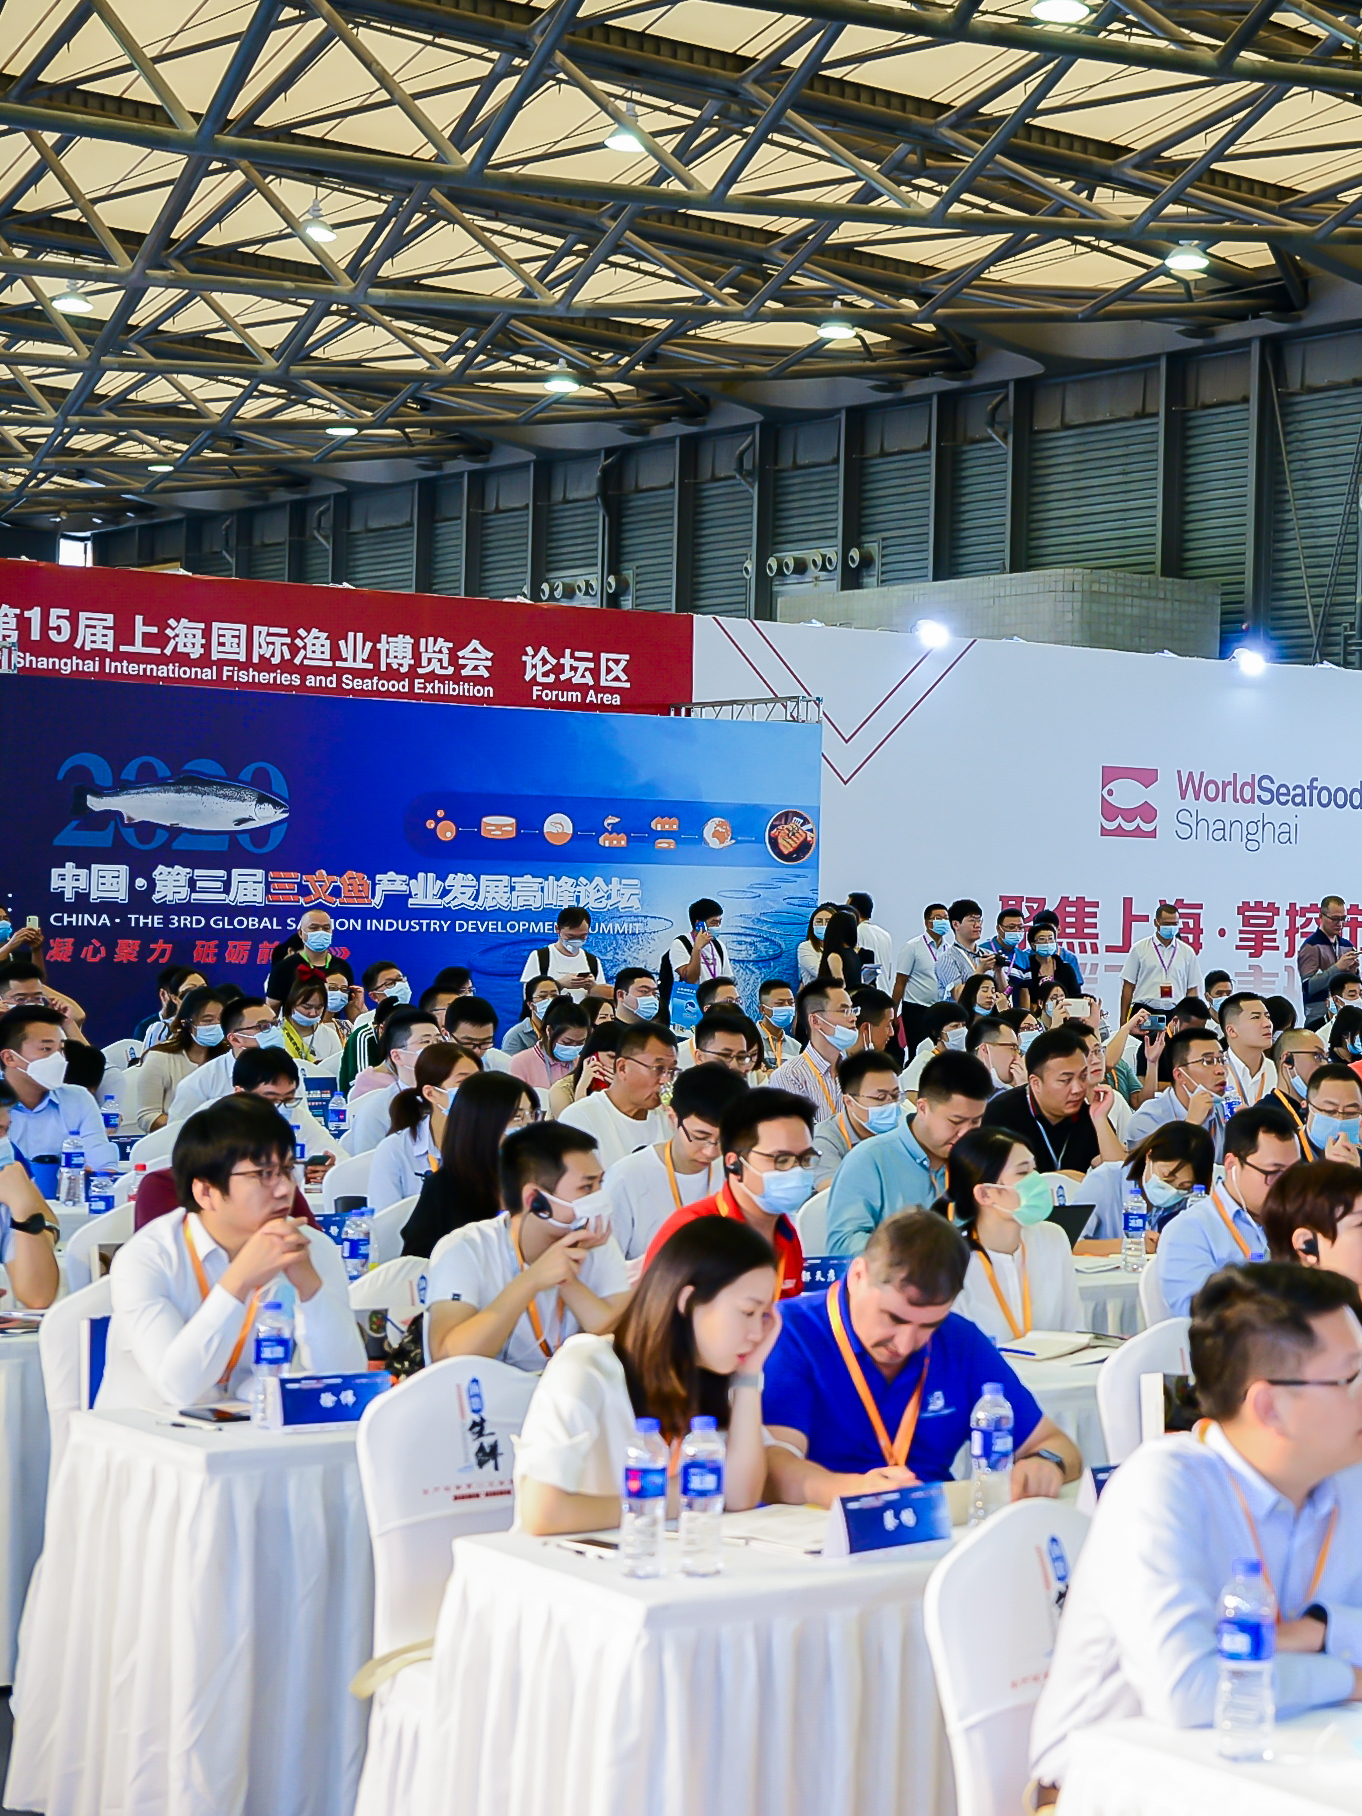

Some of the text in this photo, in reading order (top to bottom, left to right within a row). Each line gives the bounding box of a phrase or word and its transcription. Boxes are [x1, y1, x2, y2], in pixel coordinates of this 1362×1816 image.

[16, 652, 494, 698] Shanghai International Fisheries and Seafood Exhibition
[521, 645, 631, 689] 论坛区
[532, 685, 621, 706] Forum Area
[53, 752, 290, 855] 2020
[1174, 808, 1298, 853] Shanghai
[49, 912, 642, 937] CHINA THE 3RD GLOBAL SON INDUSTRY DEVELOPME UMMIT
[45, 938, 279, 966] 凝心聚力 砥砺前
